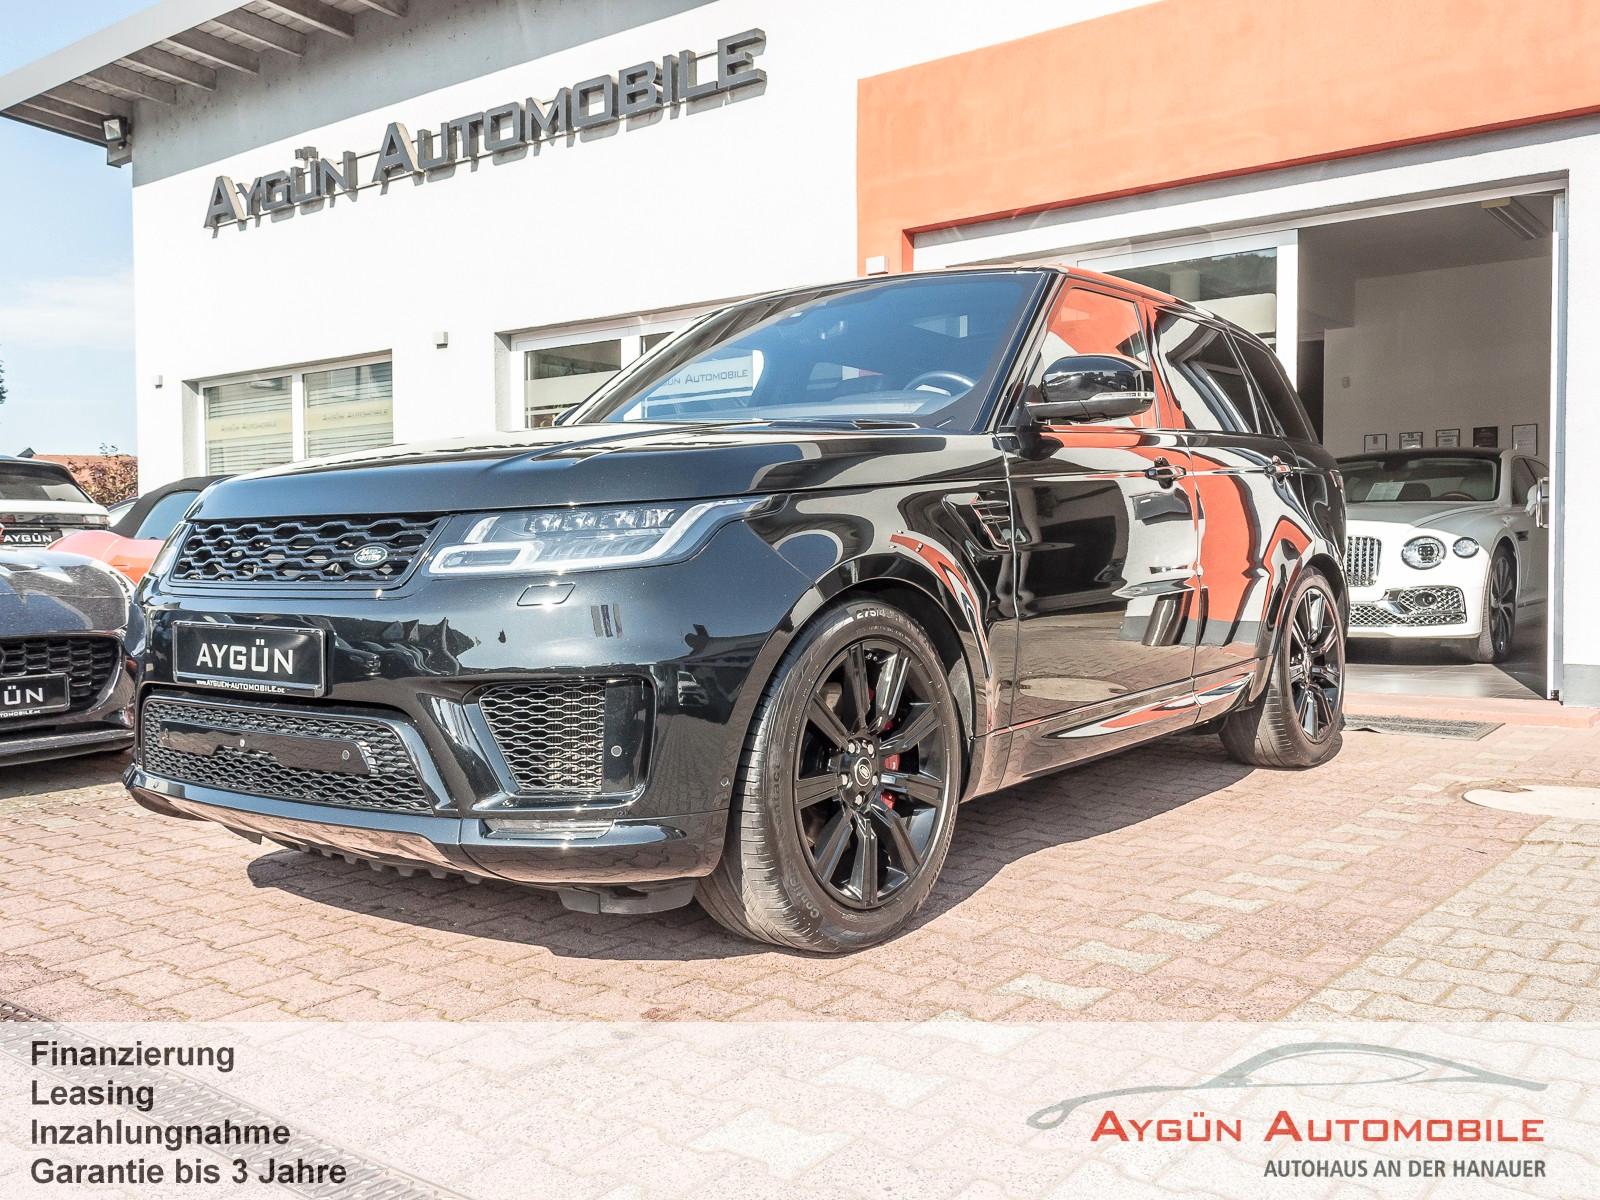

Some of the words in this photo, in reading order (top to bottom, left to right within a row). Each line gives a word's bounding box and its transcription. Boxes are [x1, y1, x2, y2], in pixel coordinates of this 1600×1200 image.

[203, 146, 357, 229] AYGÜN
[371, 27, 767, 184] AUTOMOBILE
[685, 369, 749, 385] AUTOMOBILE
[3, 532, 53, 543] AYGÜN
[196, 638, 294, 675] AYGÜN
